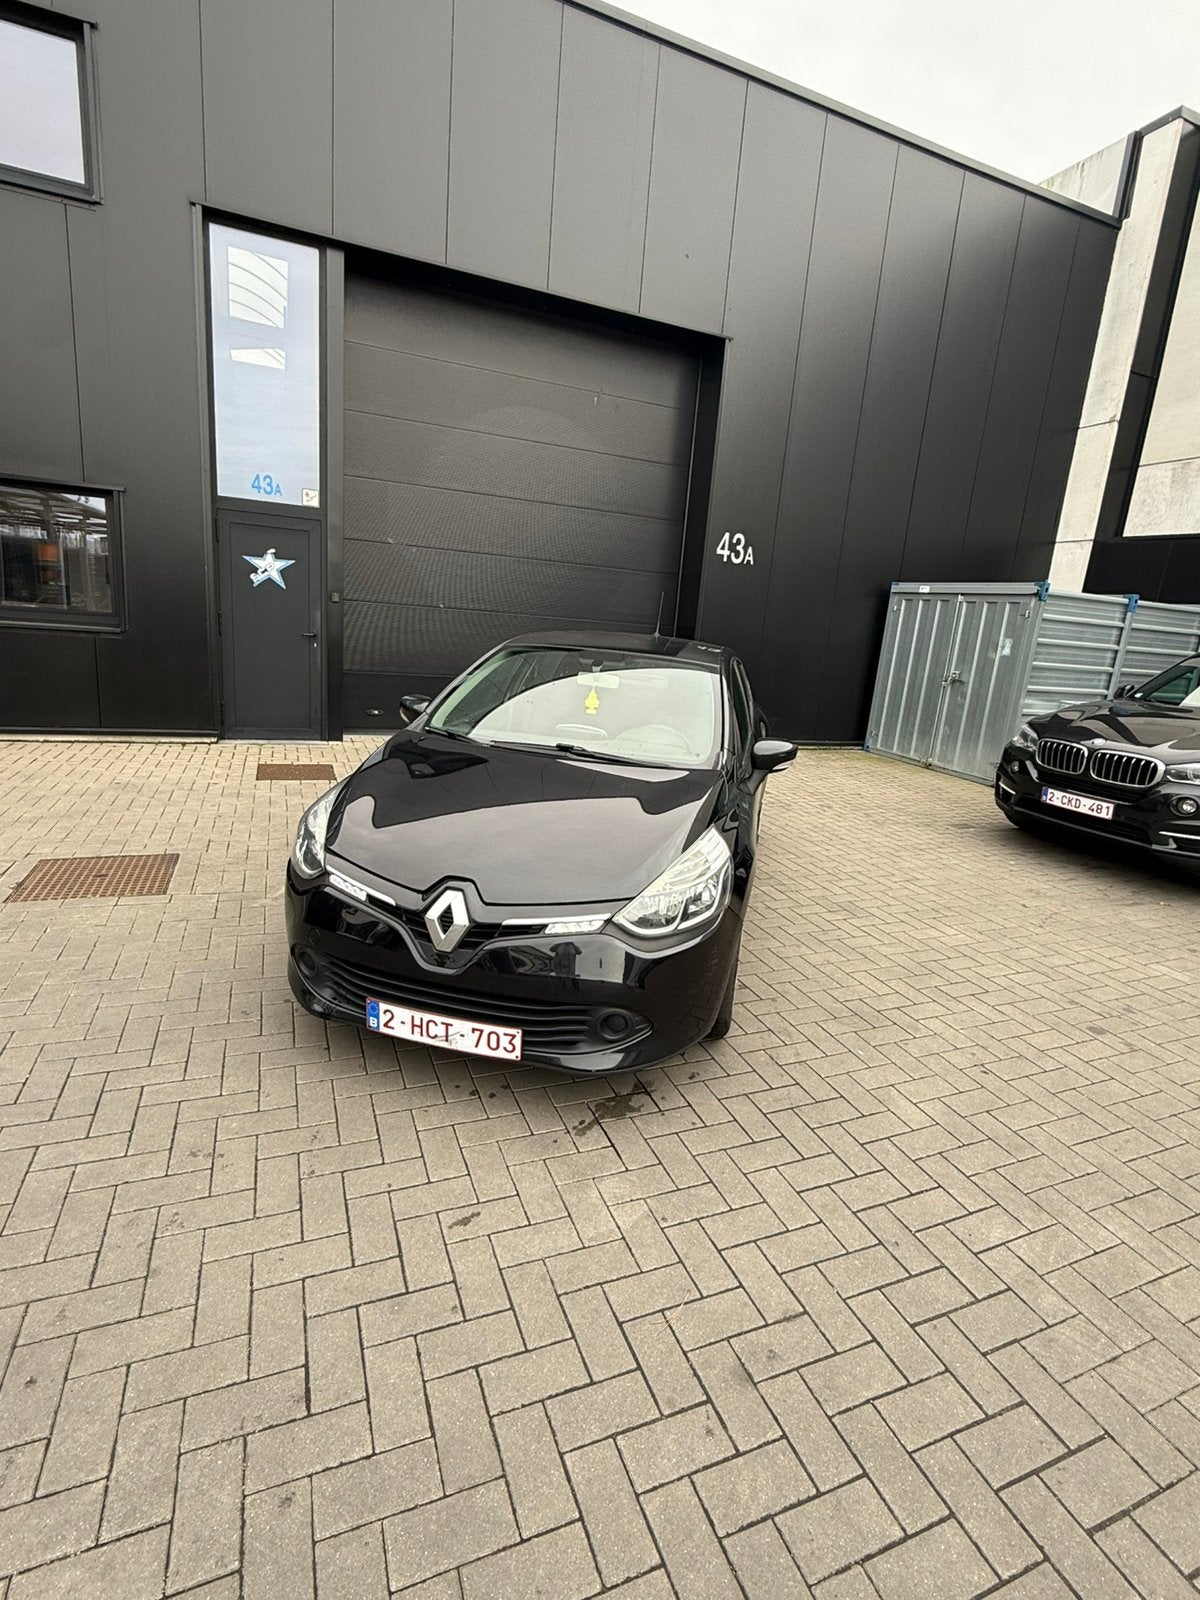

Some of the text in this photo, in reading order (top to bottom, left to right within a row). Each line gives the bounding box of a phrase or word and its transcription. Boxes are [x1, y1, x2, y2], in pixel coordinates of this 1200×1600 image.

[251, 474, 283, 496] 43A
[716, 531, 754, 565] 43A
[1048, 791, 1111, 817] 2-CKD-481
[369, 1016, 378, 1028] B
[382, 1009, 518, 1054] 2-HCT-703
